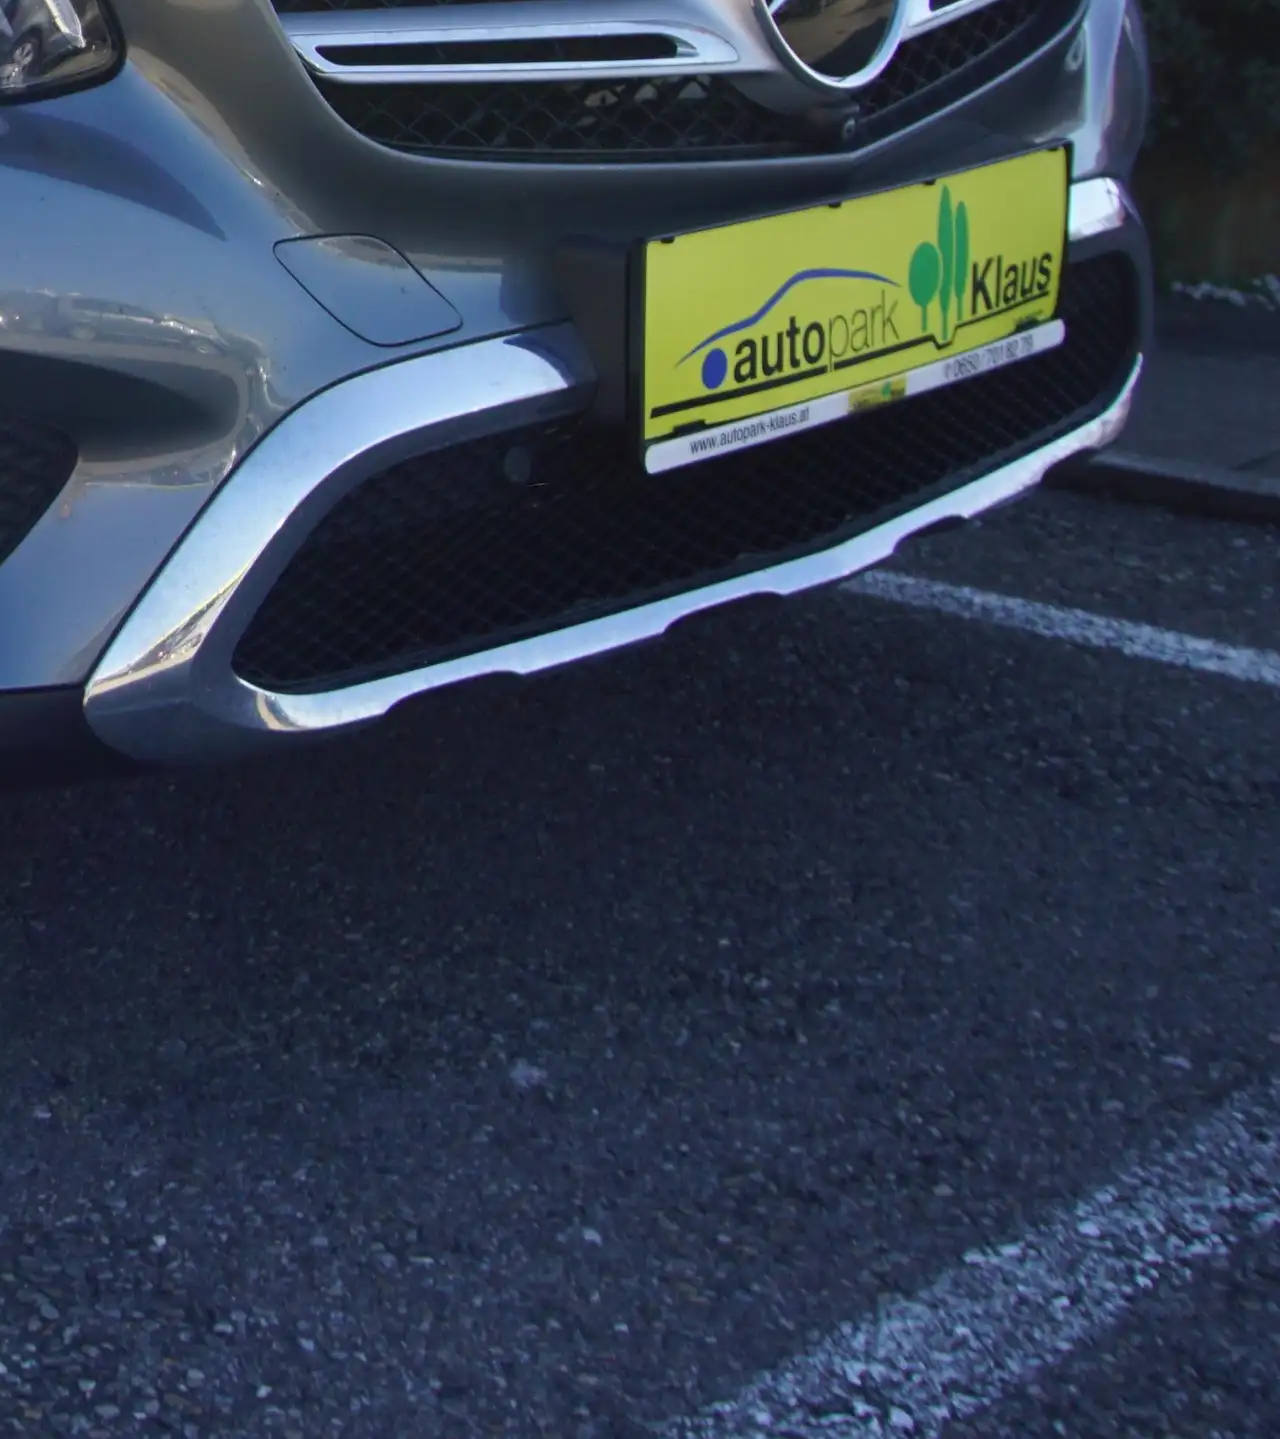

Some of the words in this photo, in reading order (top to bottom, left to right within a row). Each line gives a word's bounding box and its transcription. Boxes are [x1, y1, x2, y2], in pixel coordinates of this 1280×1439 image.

[733, 290, 901, 383] autopark
[971, 251, 1052, 316] Klaus
[689, 405, 810, 455] www.autopark-klaus.at
